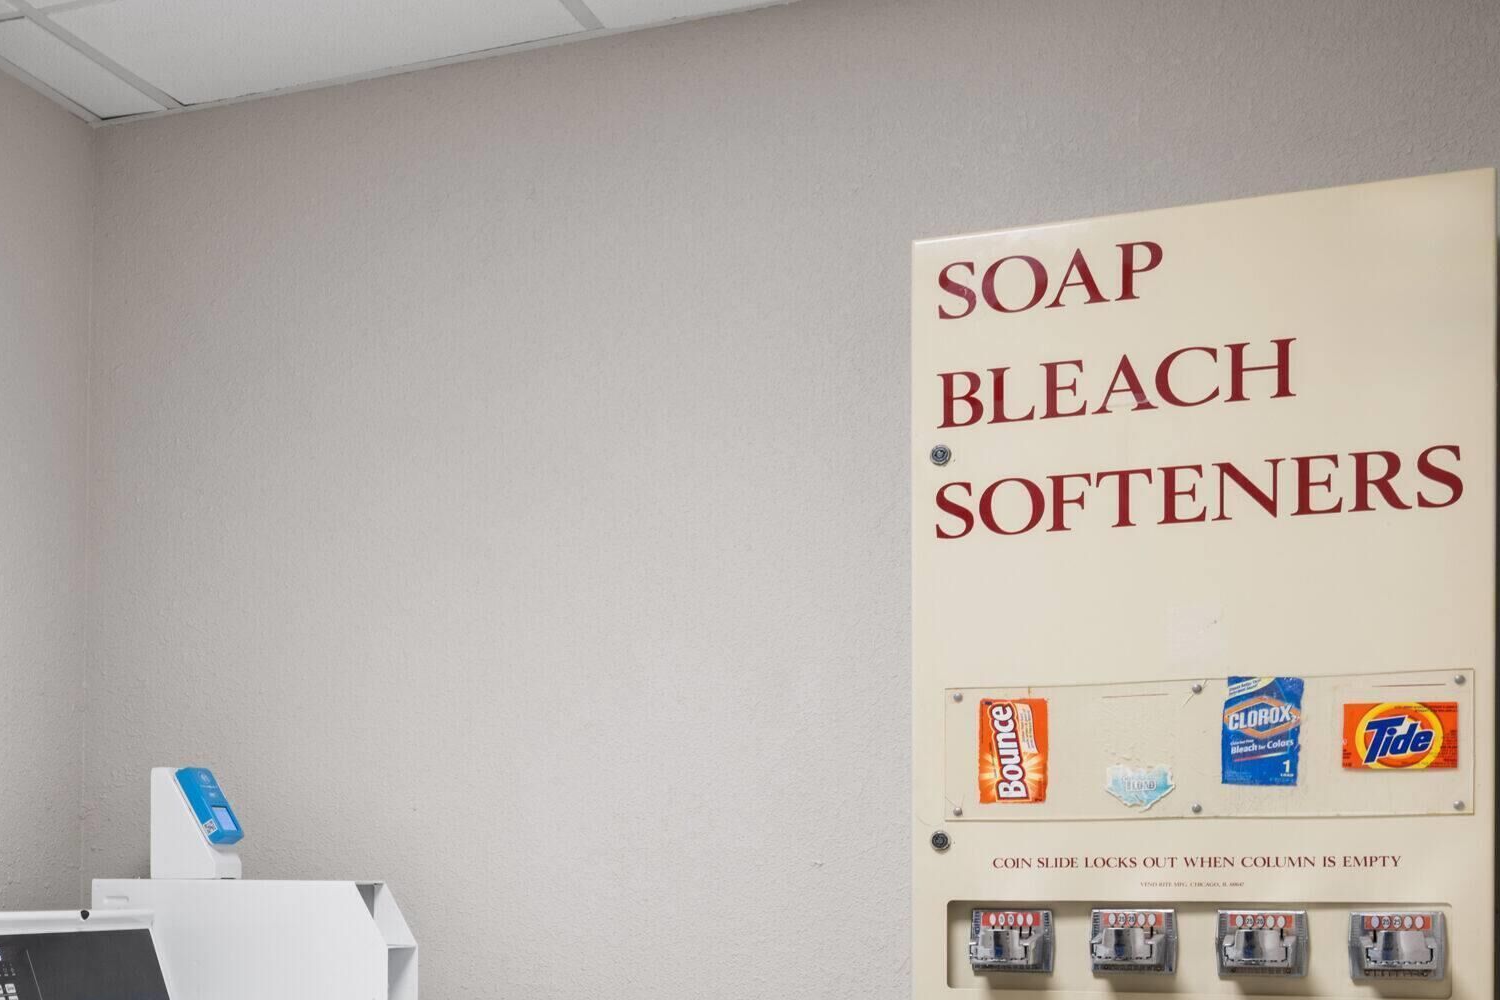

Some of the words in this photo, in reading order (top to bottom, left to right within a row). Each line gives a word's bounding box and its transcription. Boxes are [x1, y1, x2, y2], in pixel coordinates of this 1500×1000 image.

[937, 240, 1164, 320] SOAP
[936, 337, 1297, 429] BLEACH
[935, 444, 1464, 539] SOFTENERS
[1228, 703, 1293, 730] CLOROX
[1363, 715, 1434, 765] Tide
[991, 705, 1028, 798] Bounce
[1231, 743, 1257, 755] Bleach
[1267, 739, 1294, 749] Colors
[1282, 760, 1290, 773] 1
[993, 857, 1032, 869] COIN
[1037, 857, 1078, 869] SLIDE
[1084, 856, 1137, 868] LOCKS
[1143, 856, 1177, 868] OUT
[1184, 856, 1235, 868] WHEN
[1240, 856, 1315, 868] COLUMN
[1323, 856, 1336, 867] IS
[1343, 855, 1402, 867] EMPTY
